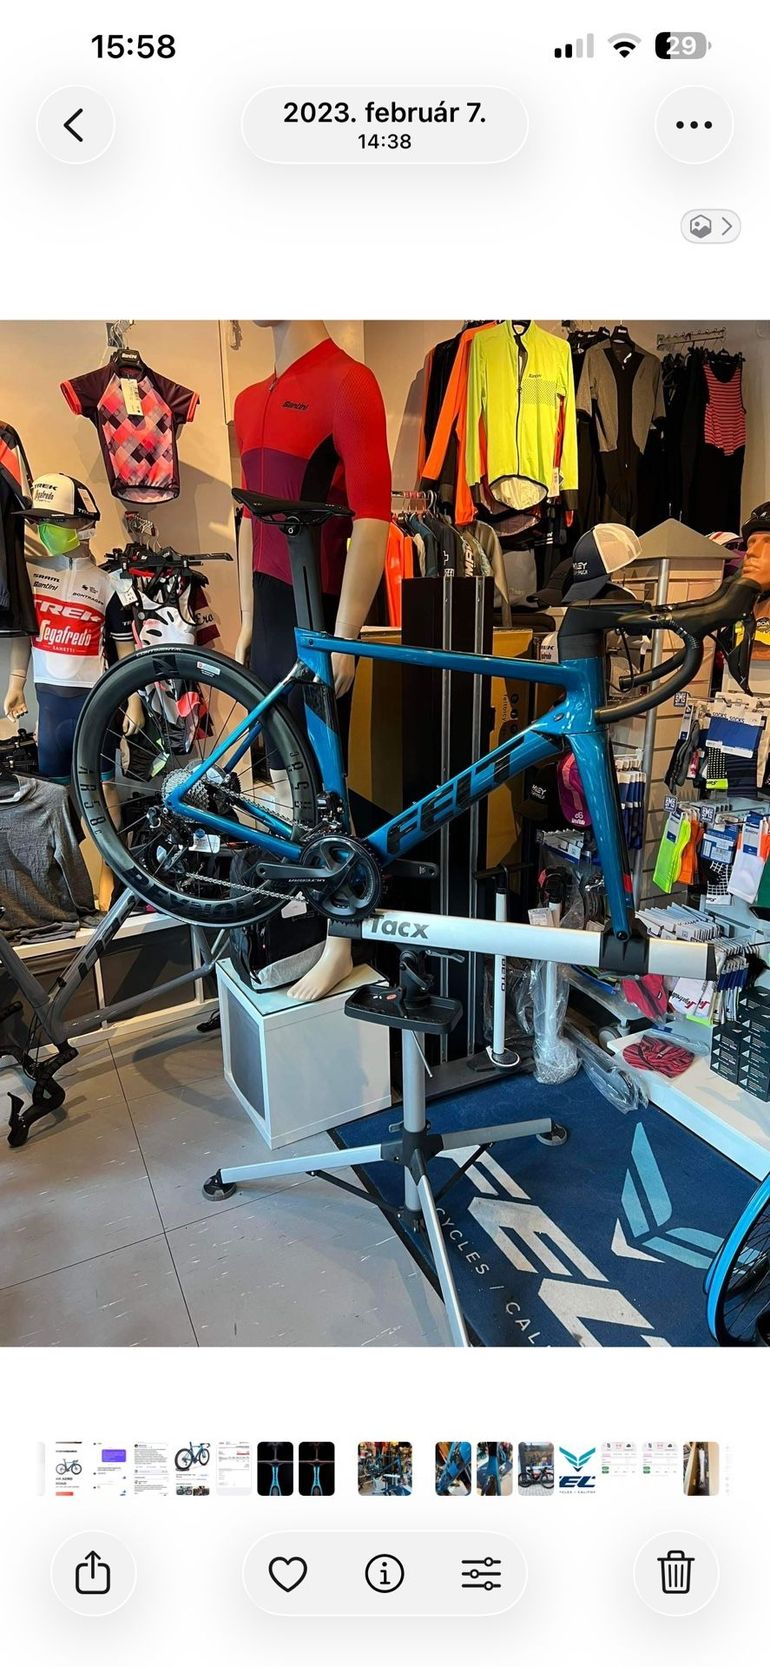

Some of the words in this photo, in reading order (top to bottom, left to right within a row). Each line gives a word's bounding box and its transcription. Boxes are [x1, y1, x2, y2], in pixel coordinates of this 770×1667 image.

[91, 34, 177, 59] 15:58
[666, 35, 697, 56] 29
[283, 101, 358, 124] 2023.
[364, 101, 460, 124] február
[466, 101, 487, 124] 7.
[358, 133, 412, 150] 14:38
[36, 619, 92, 647] Segafredo
[387, 736, 524, 855] FELT
[436, 1207, 490, 1275] CYCLES
